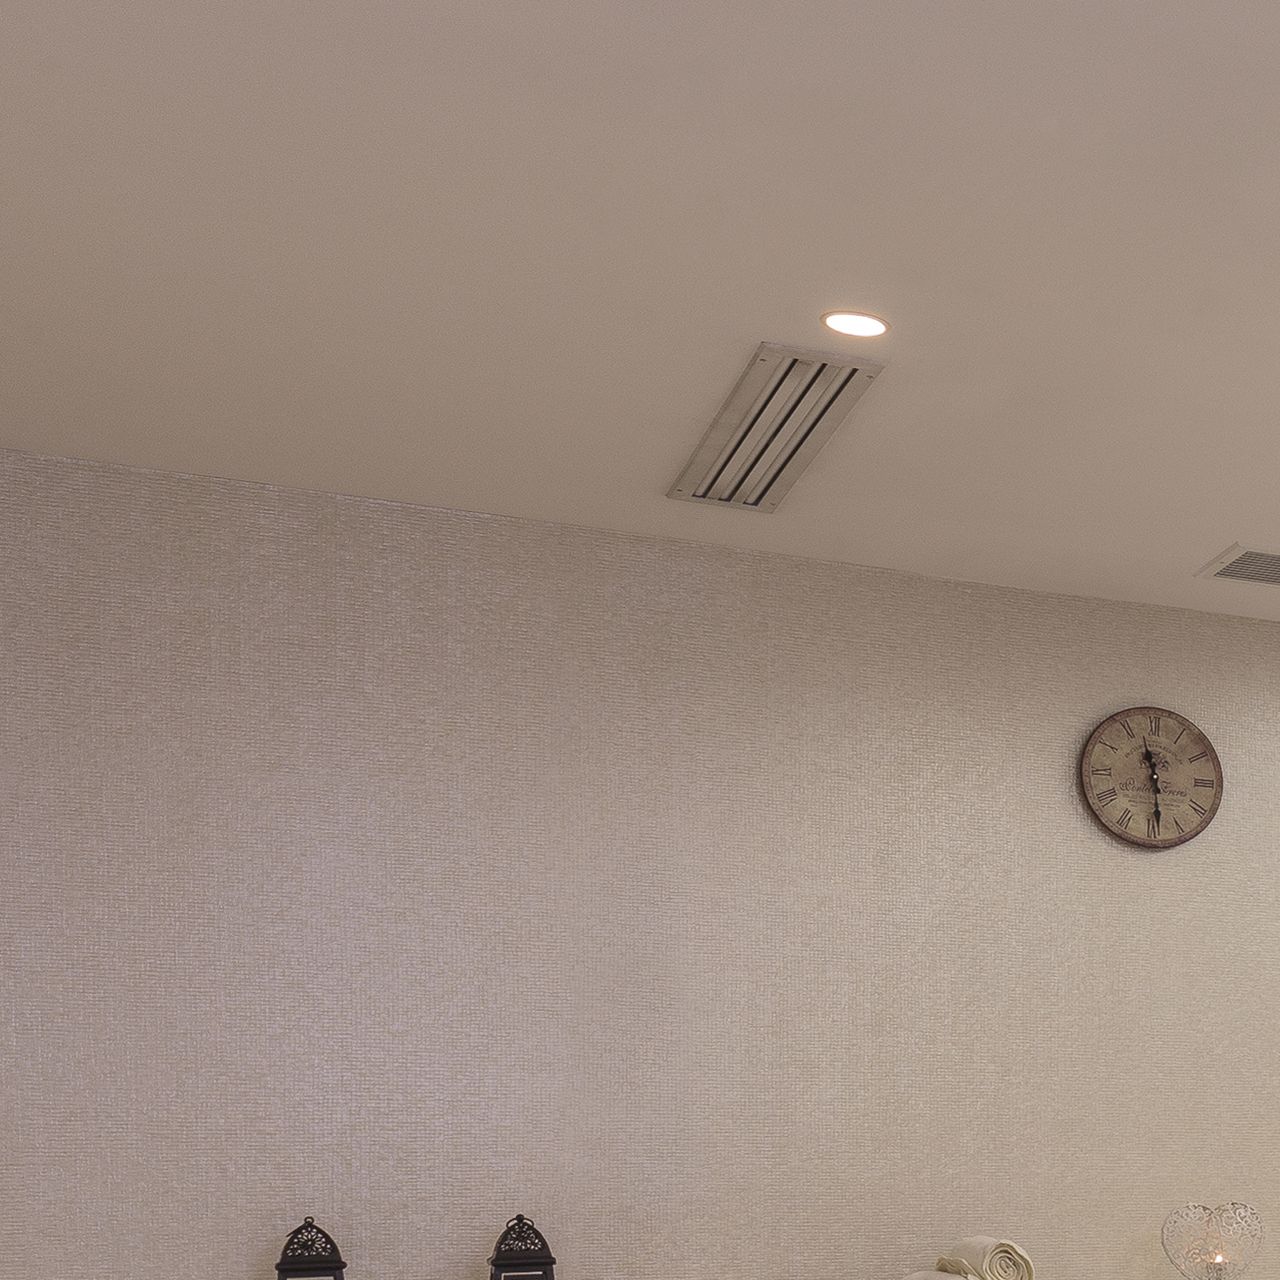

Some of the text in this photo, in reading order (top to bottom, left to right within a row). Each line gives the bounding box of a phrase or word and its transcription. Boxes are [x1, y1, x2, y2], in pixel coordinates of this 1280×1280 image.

[1148, 715, 1161, 737] XII
[1098, 737, 1119, 753] X
[1173, 727, 1186, 745] I
[1187, 751, 1208, 764] II
[1091, 766, 1112, 777] IX
[1193, 777, 1214, 789] III
[1096, 787, 1118, 808] VIII
[1116, 807, 1134, 830] VII
[1188, 799, 1208, 819] IV
[1146, 818, 1161, 839] VI
[1172, 816, 1185, 835] V
